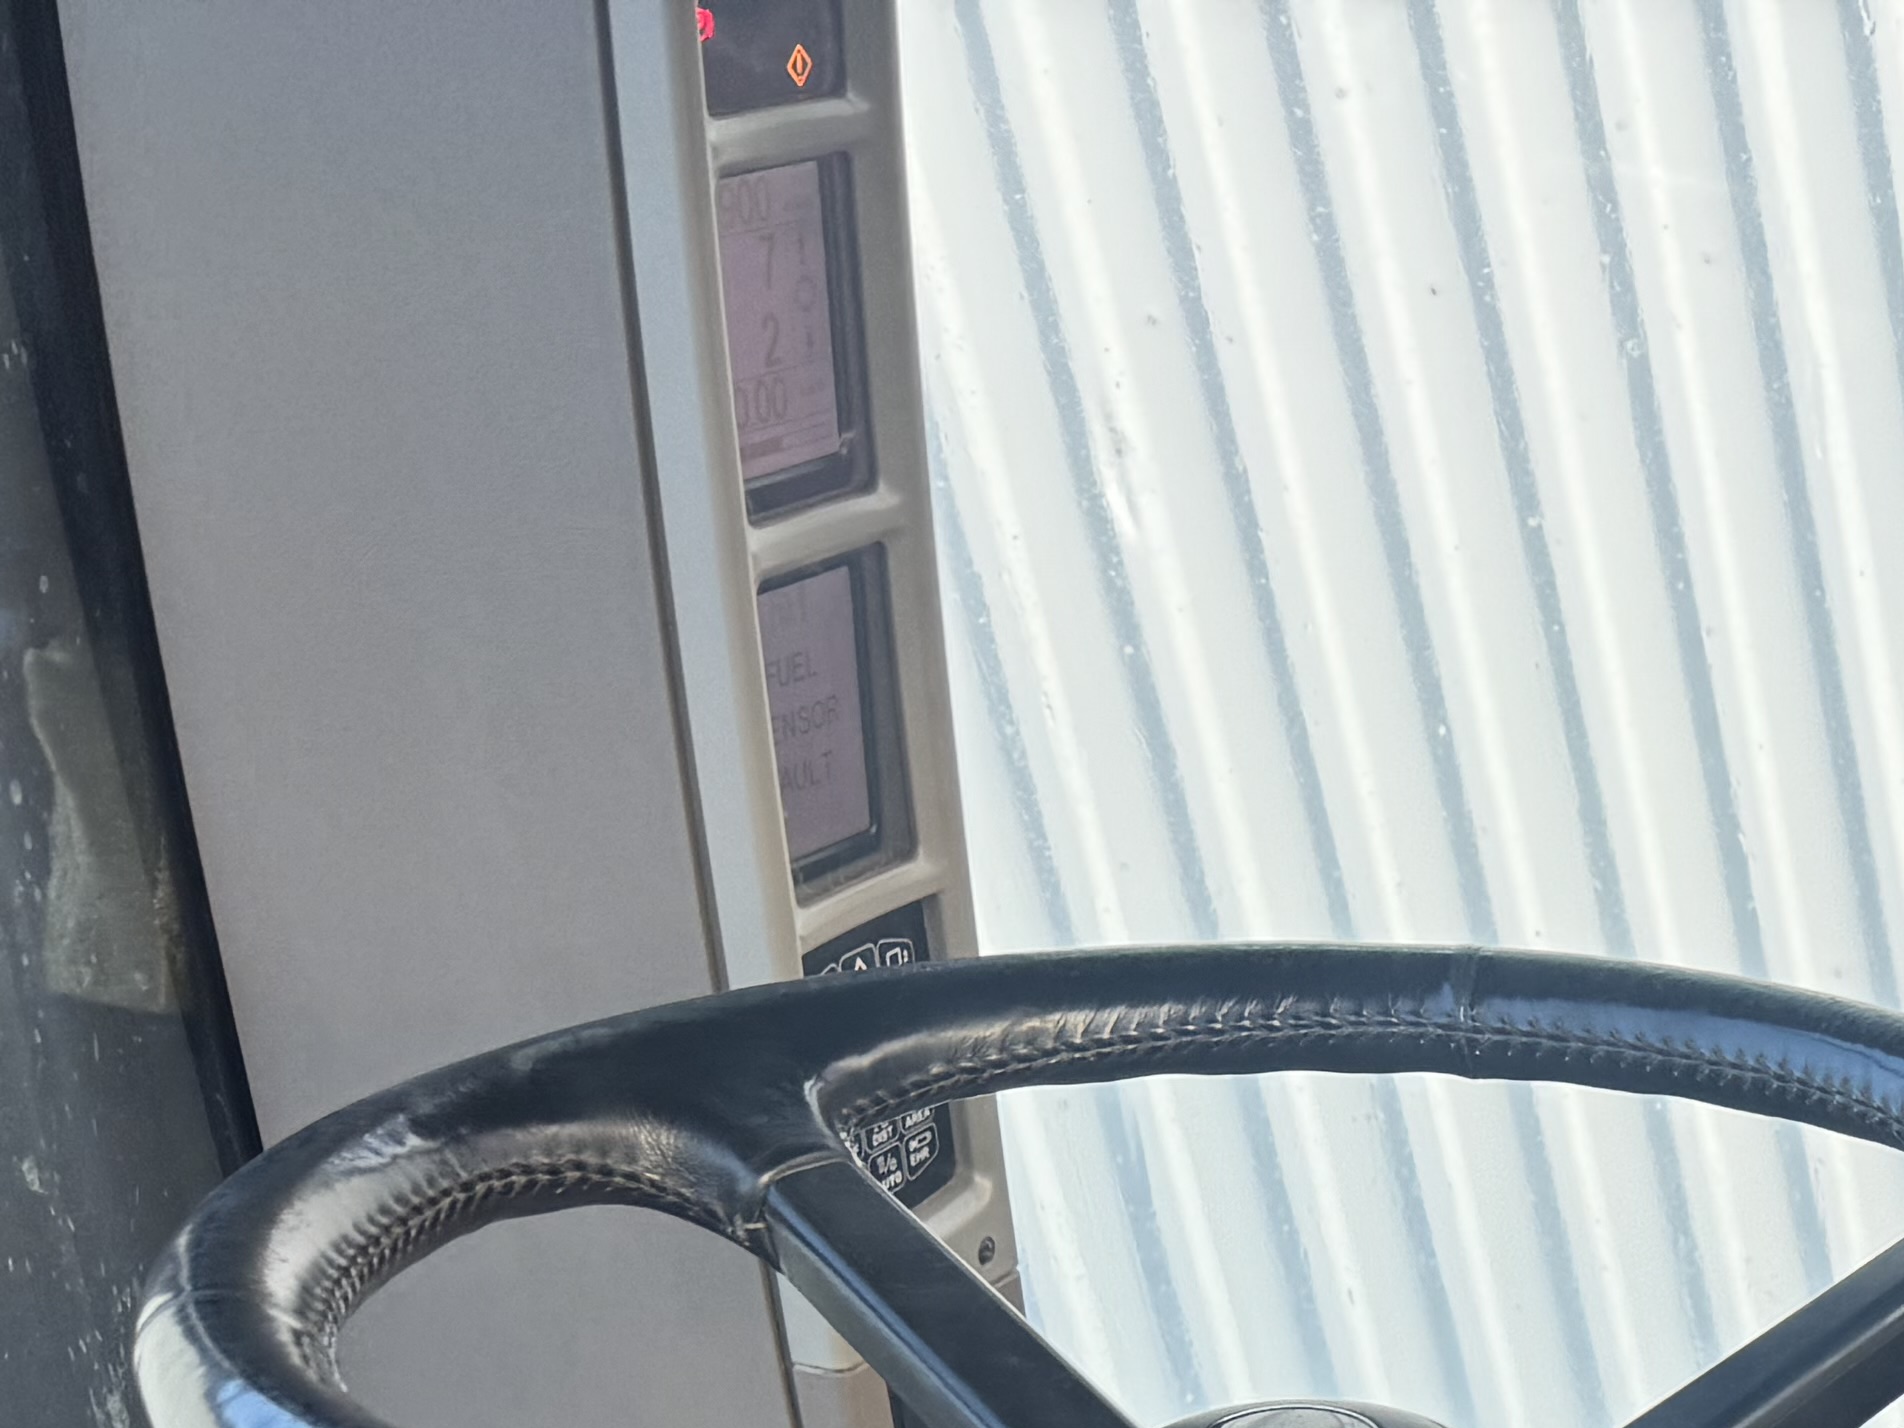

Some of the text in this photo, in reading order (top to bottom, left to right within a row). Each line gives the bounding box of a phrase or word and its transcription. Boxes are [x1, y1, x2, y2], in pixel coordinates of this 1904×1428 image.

[762, 311, 782, 369] 2
[767, 651, 818, 687] FUEL
[770, 693, 840, 745] ENSOR
[780, 750, 833, 791] AULT
[881, 1170, 903, 1189] UTO
